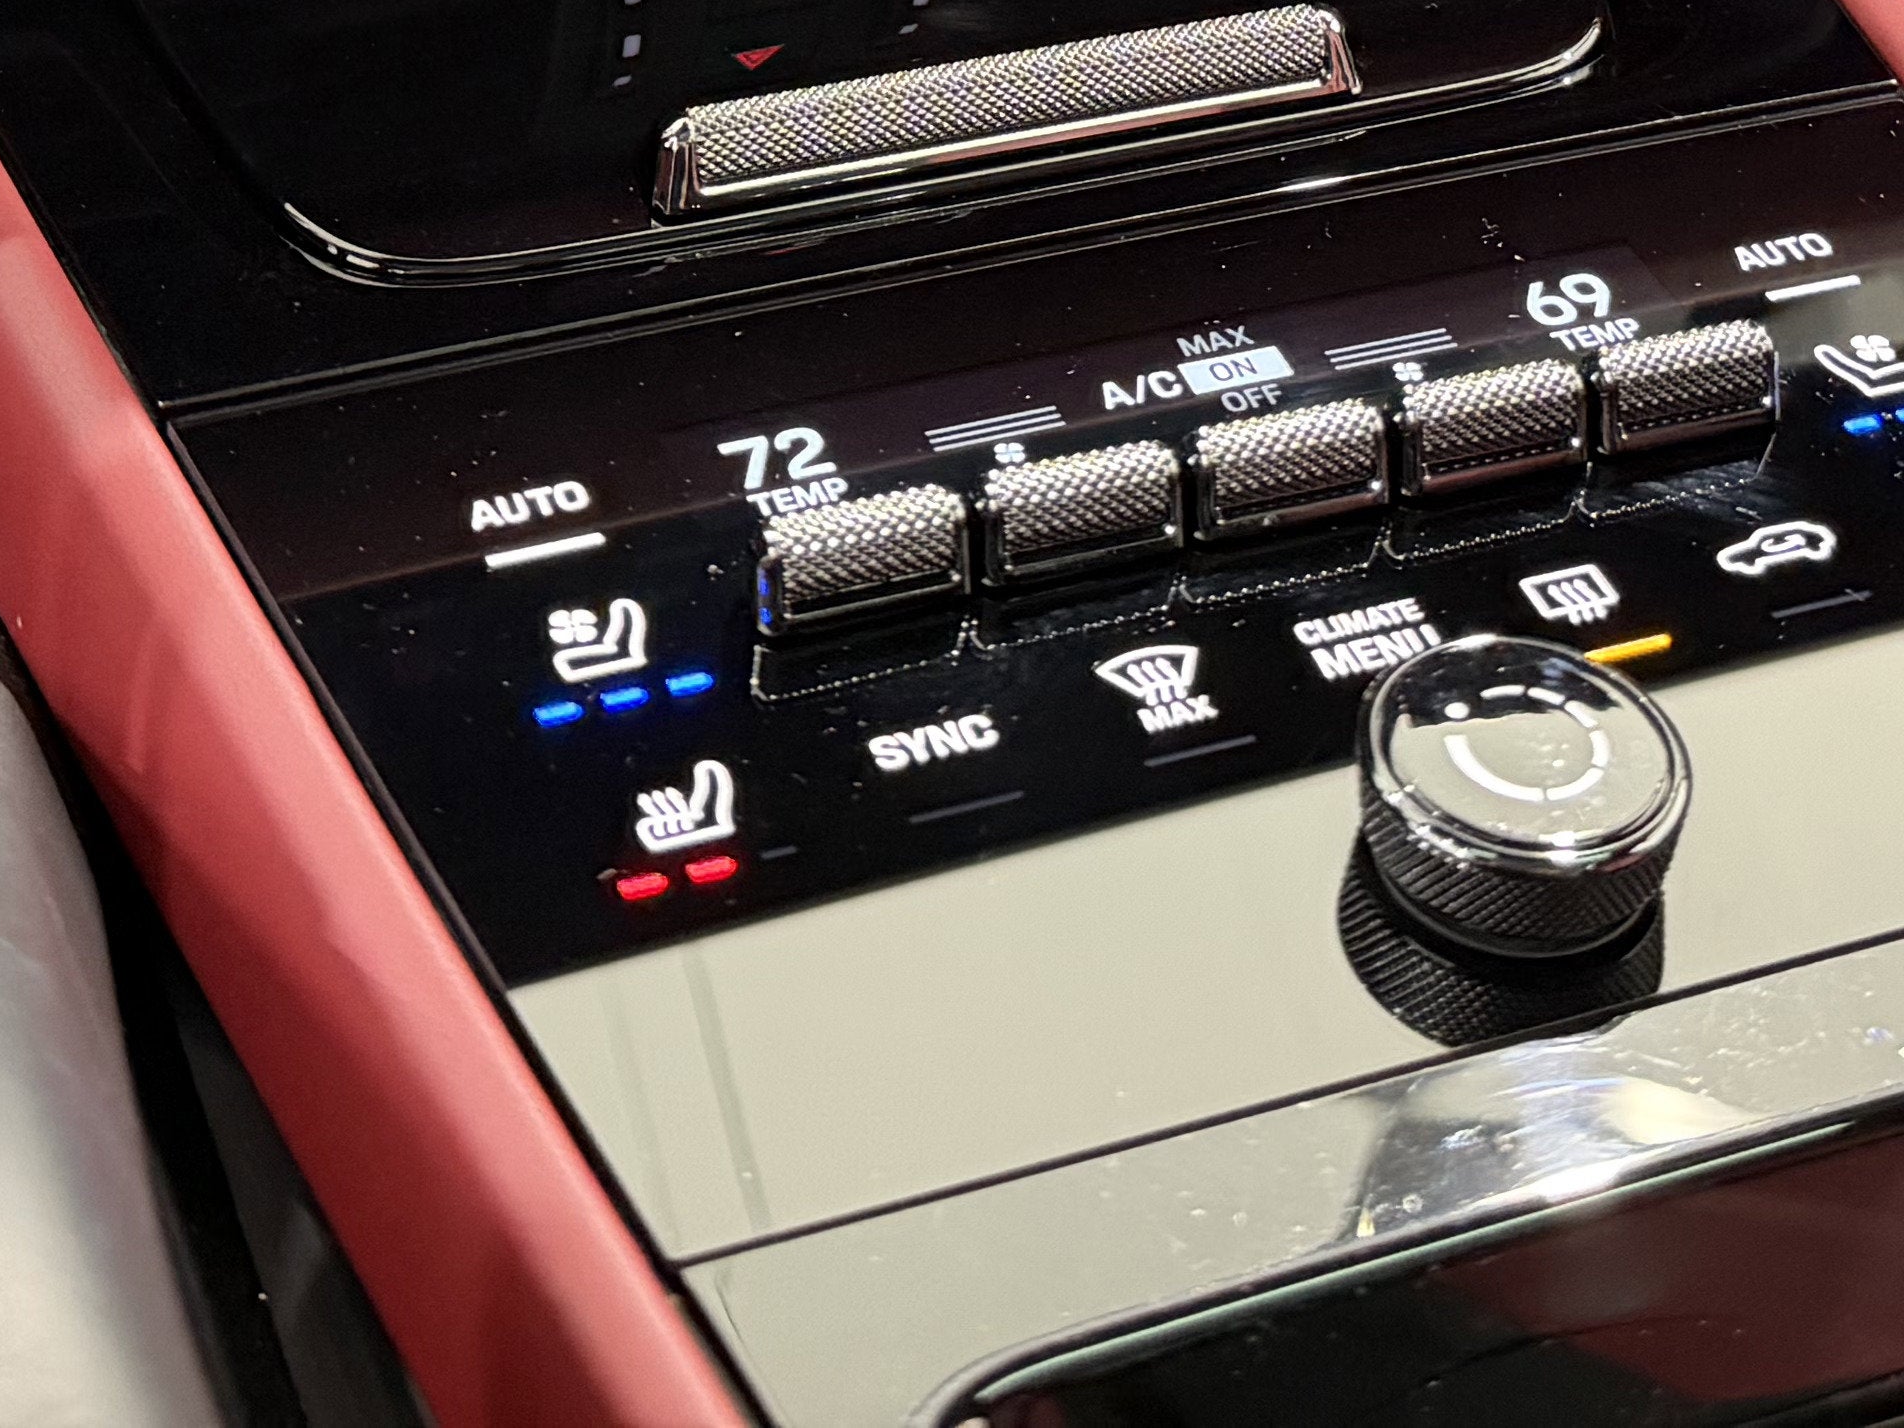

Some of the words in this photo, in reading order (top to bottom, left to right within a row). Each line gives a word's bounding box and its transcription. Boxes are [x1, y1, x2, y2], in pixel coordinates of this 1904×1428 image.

[1734, 232, 1834, 273] AUTO
[1526, 273, 1611, 326] 69
[1176, 325, 1255, 357] MAX
[1549, 317, 1640, 352] TEMP
[1209, 356, 1258, 382] ON
[1102, 370, 1183, 410] A/C
[1221, 382, 1282, 412] OFF
[717, 427, 837, 490] 72
[470, 480, 591, 532] AUTO
[746, 477, 849, 517] TEMP
[1293, 597, 1426, 646] CLIMATE
[1136, 694, 1219, 734] MAX
[867, 713, 1000, 772] SYNC
